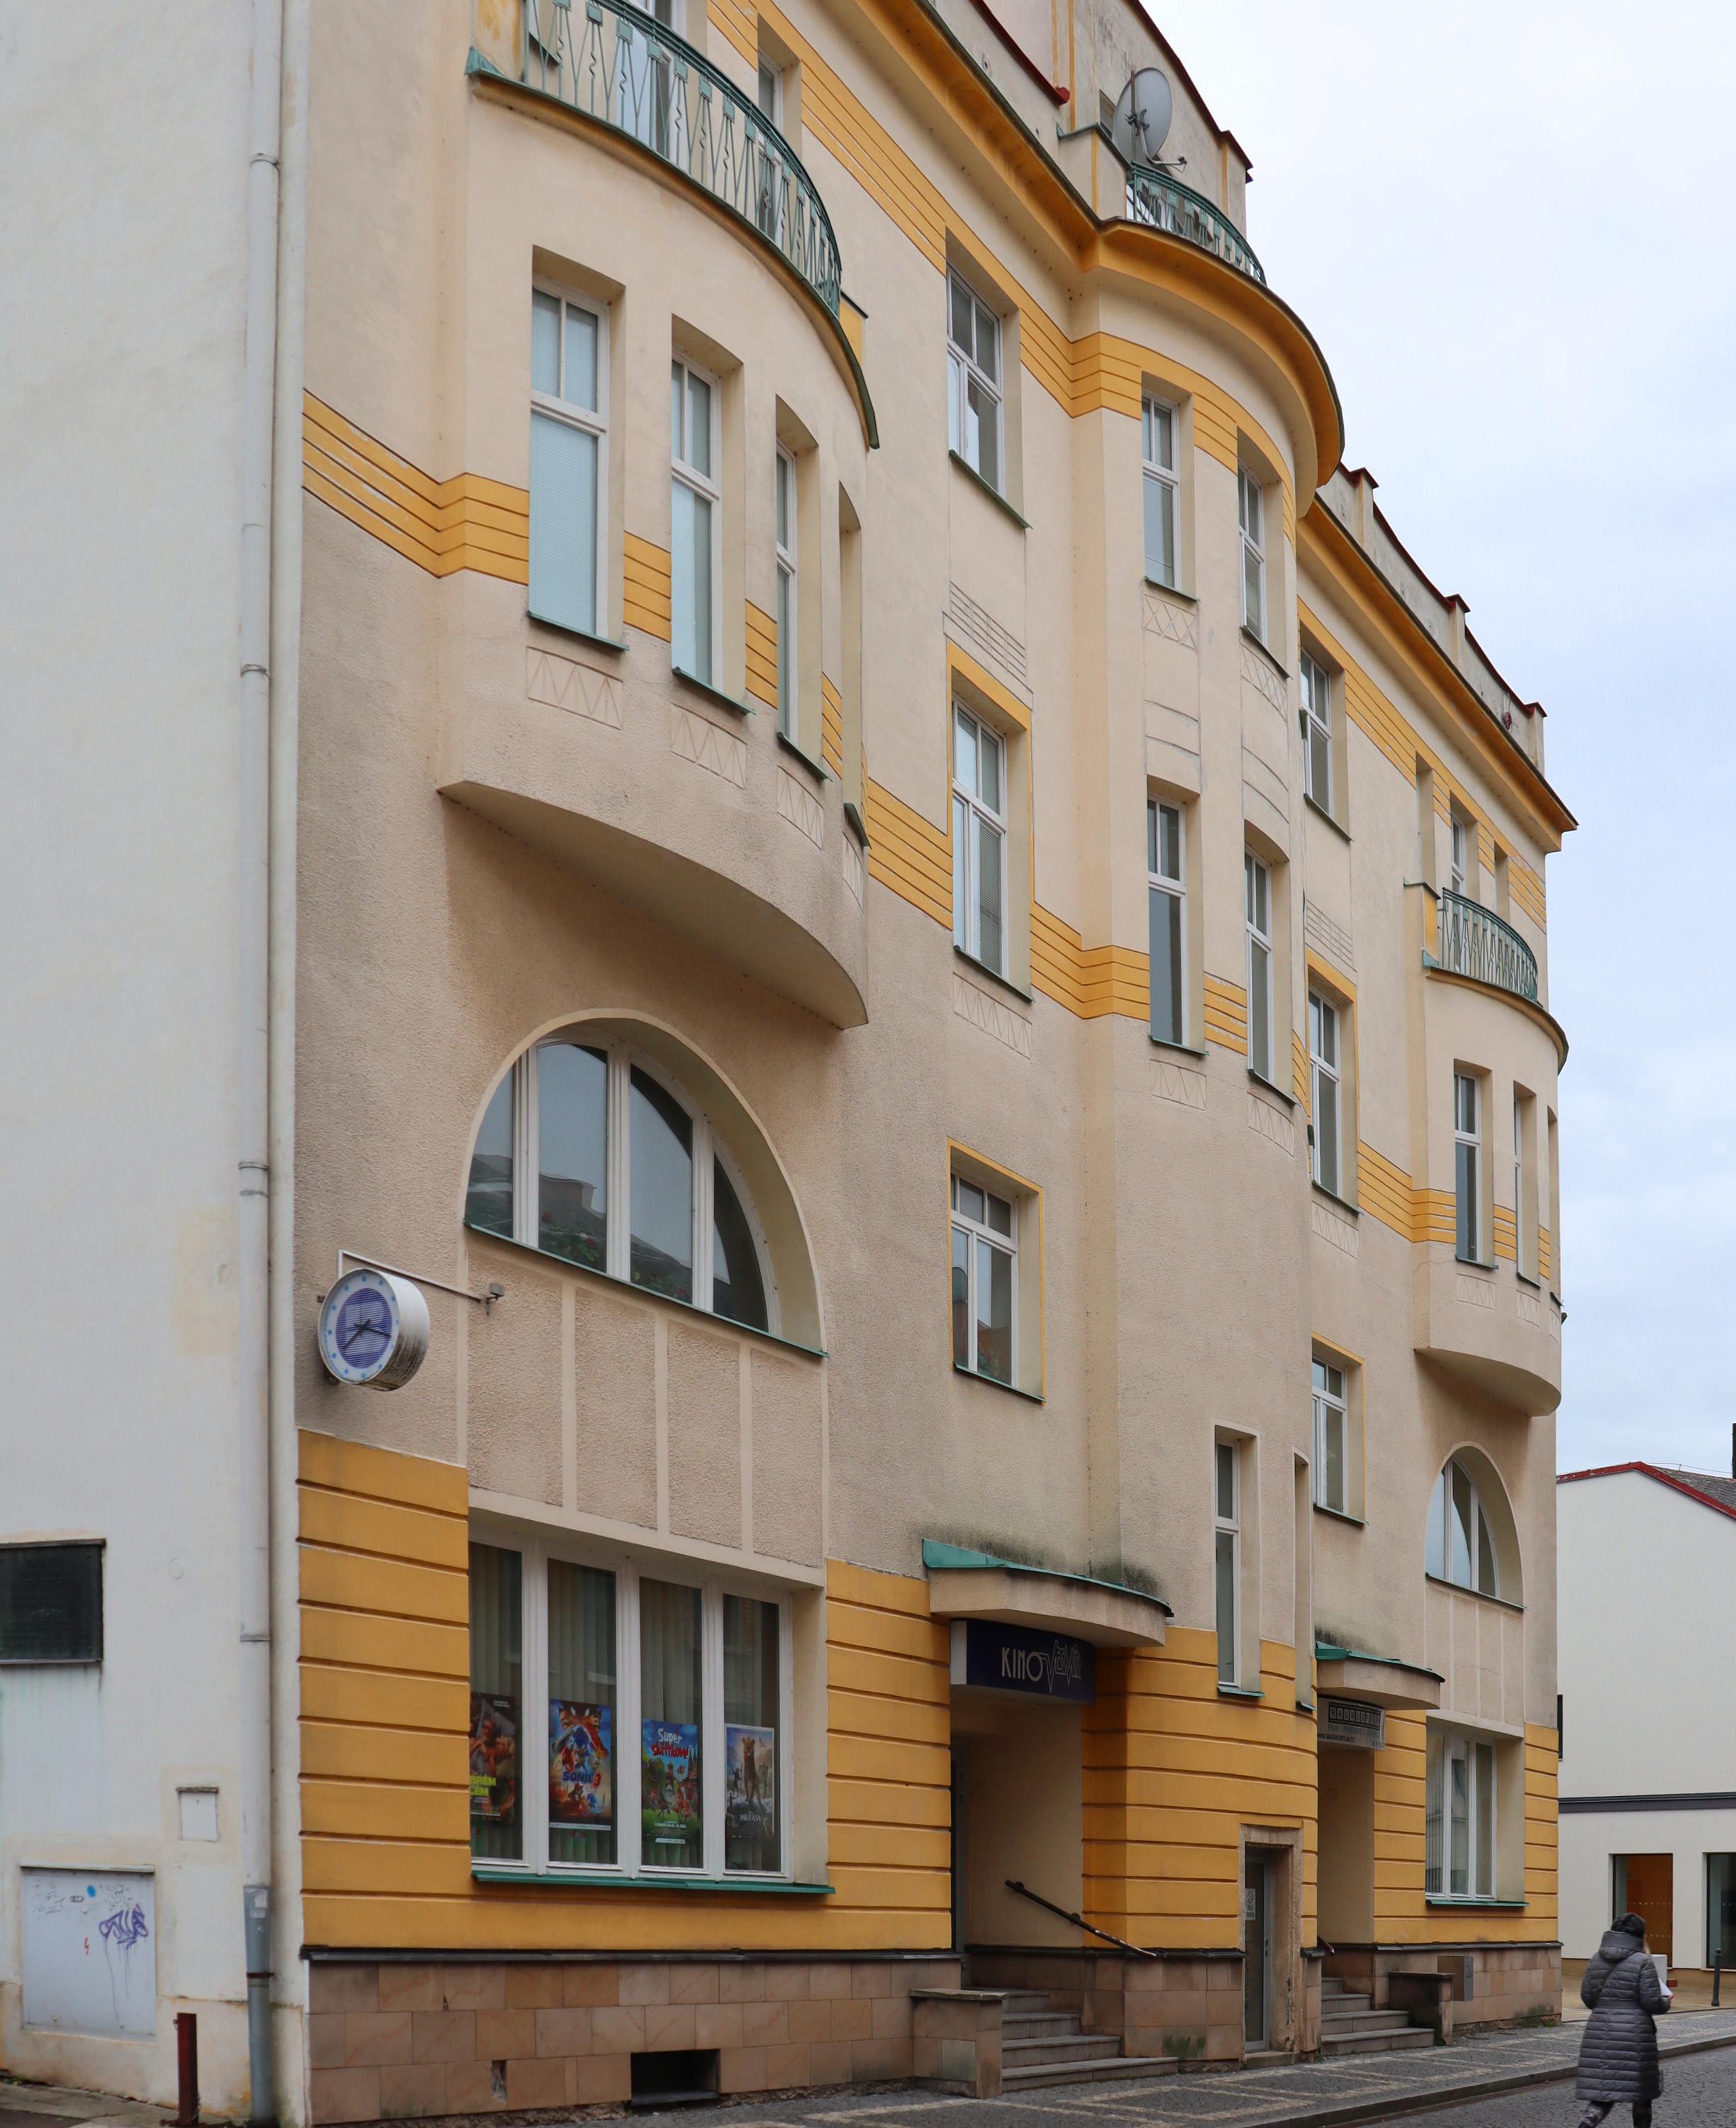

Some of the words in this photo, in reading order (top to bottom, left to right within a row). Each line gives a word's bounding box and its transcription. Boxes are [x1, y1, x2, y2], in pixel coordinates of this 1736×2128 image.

[1001, 1646, 1043, 1682] KINO
[658, 1728, 682, 1745] Super
[562, 1770, 594, 1783] SONIC
[593, 1771, 602, 1787] 3
